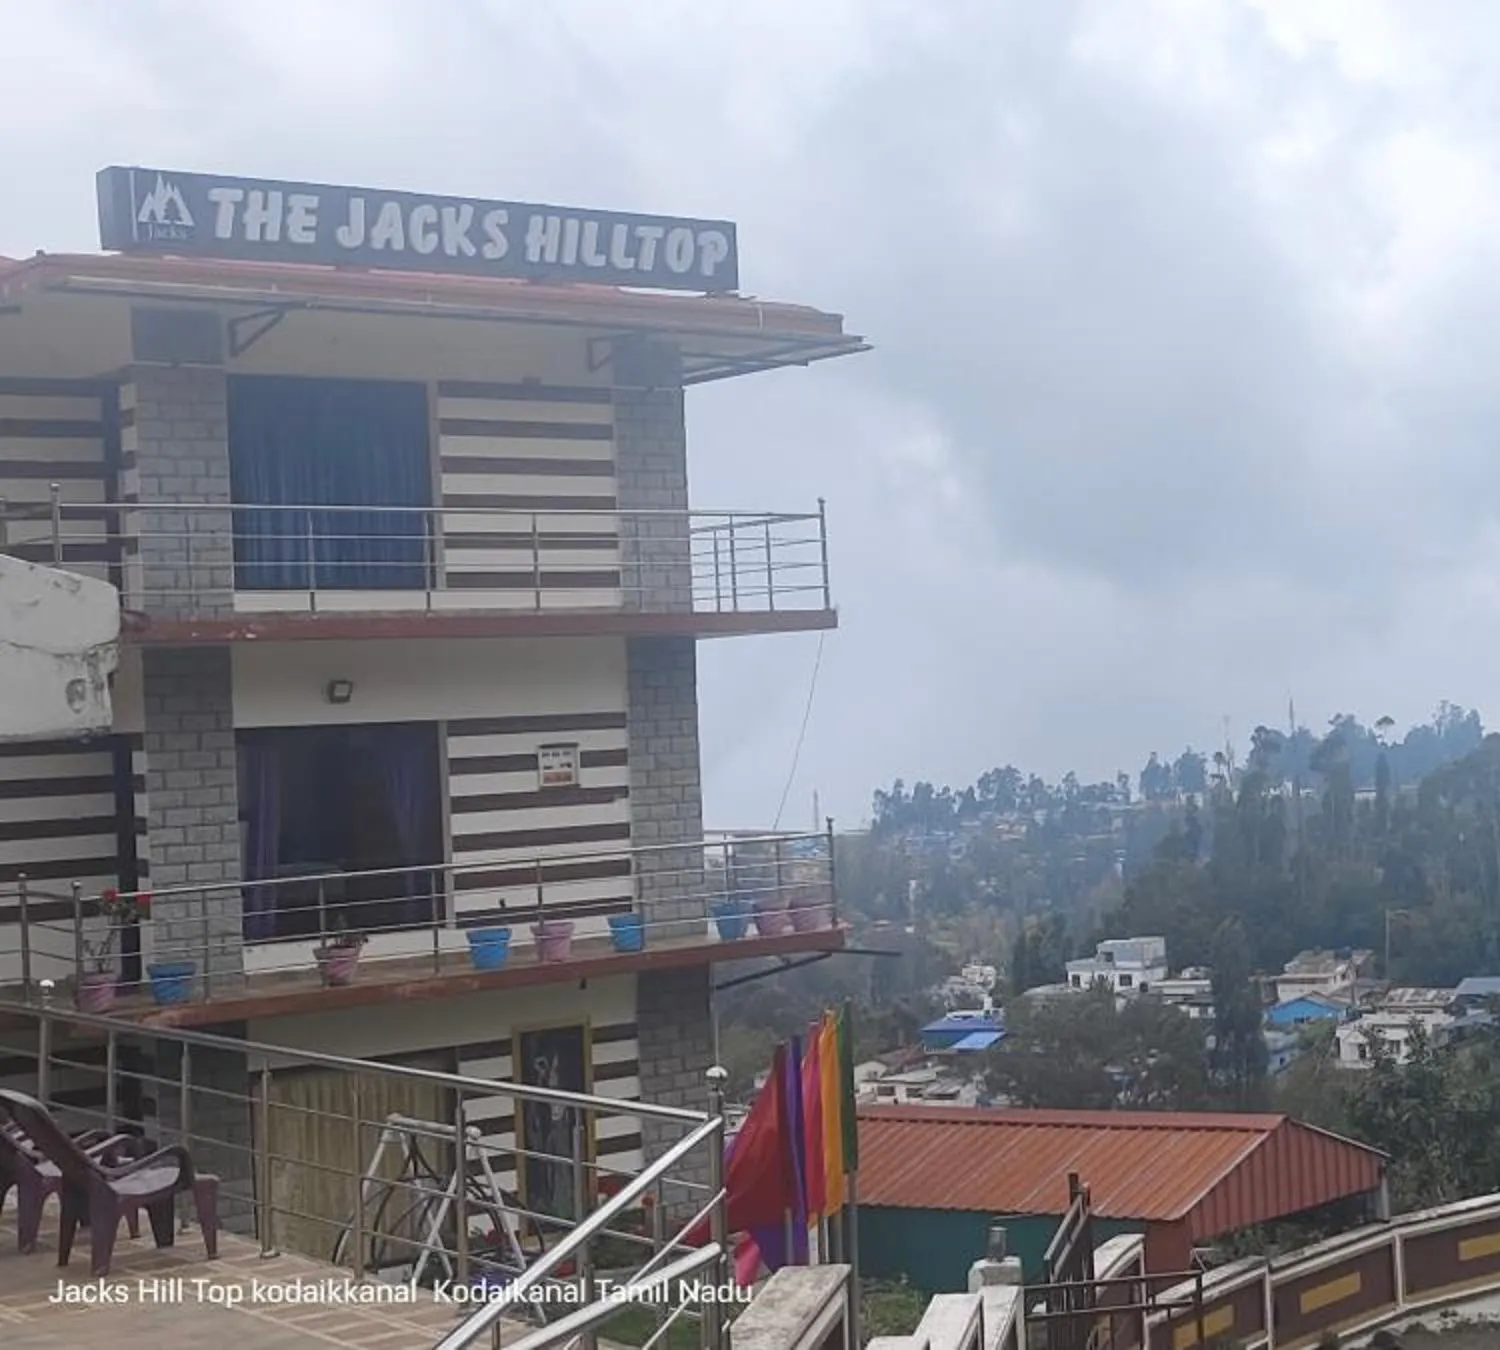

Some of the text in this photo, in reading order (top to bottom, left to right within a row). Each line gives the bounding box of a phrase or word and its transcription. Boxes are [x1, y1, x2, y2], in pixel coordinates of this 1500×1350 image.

[208, 187, 729, 276] THE JACKS HILLTOP
